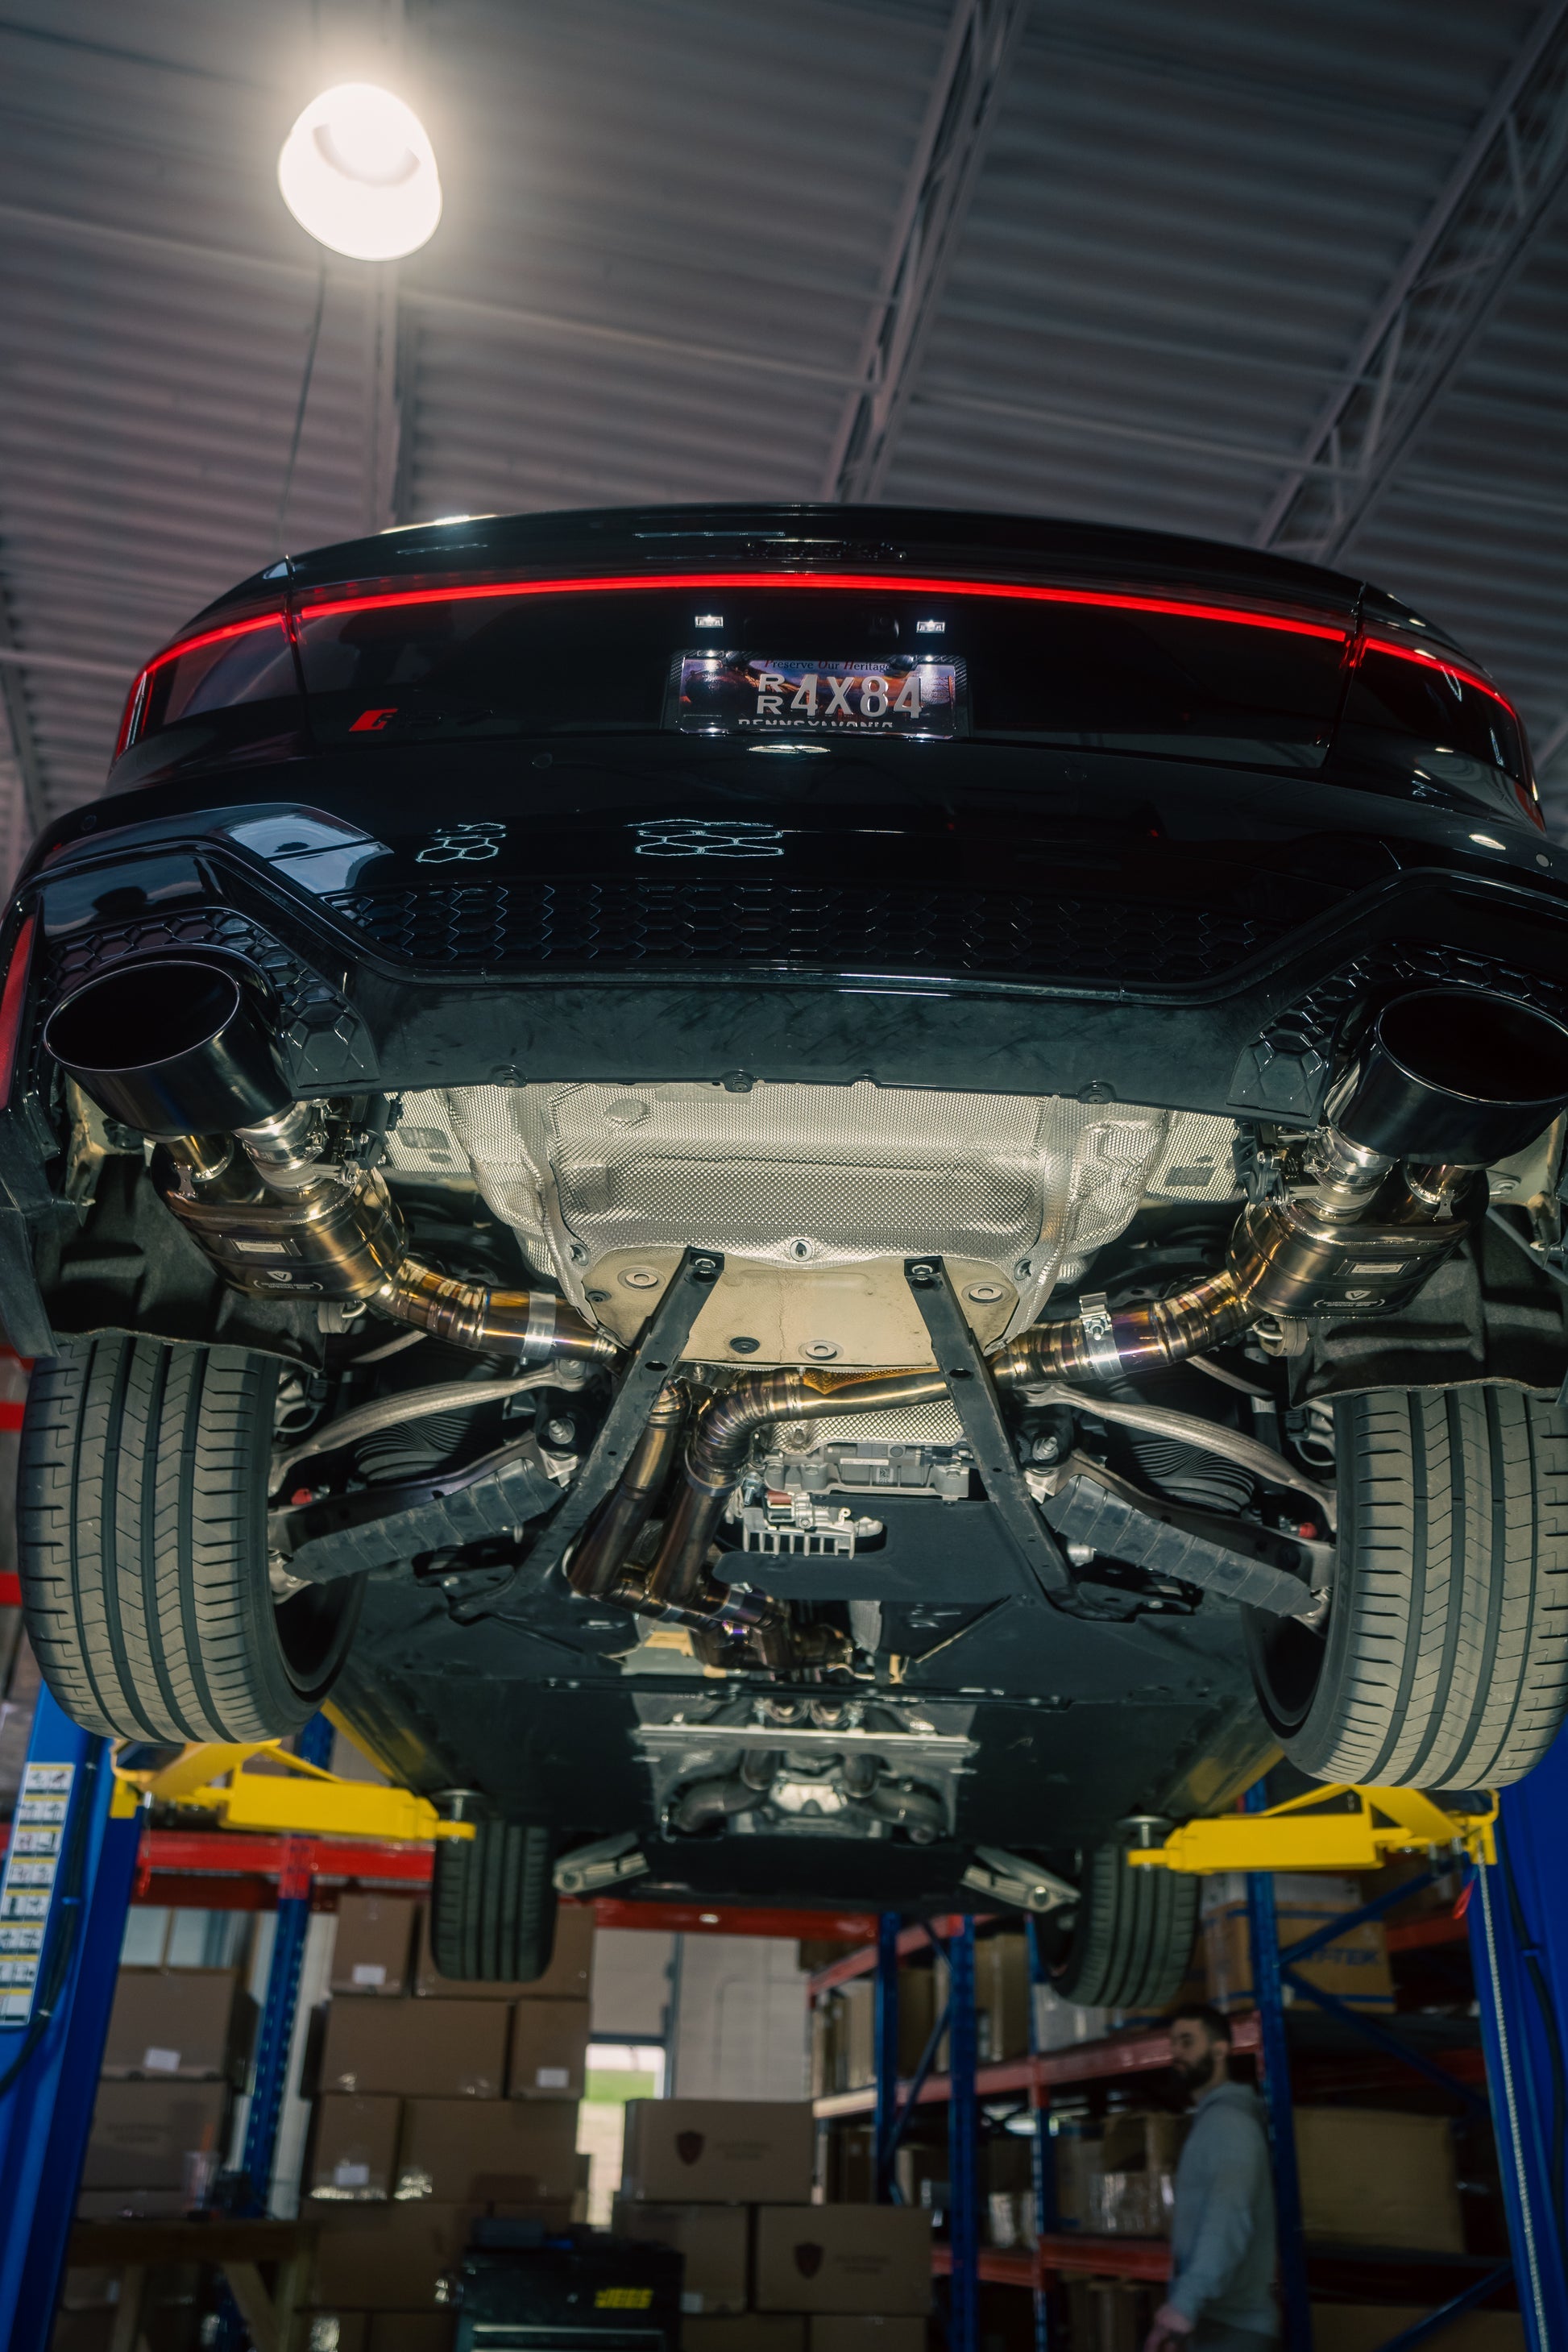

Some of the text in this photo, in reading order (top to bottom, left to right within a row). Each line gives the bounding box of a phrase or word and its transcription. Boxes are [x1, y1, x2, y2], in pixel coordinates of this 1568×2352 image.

[764, 659, 814, 670] Preserve
[818, 660, 840, 670] Our
[790, 674, 923, 719] 4X84
